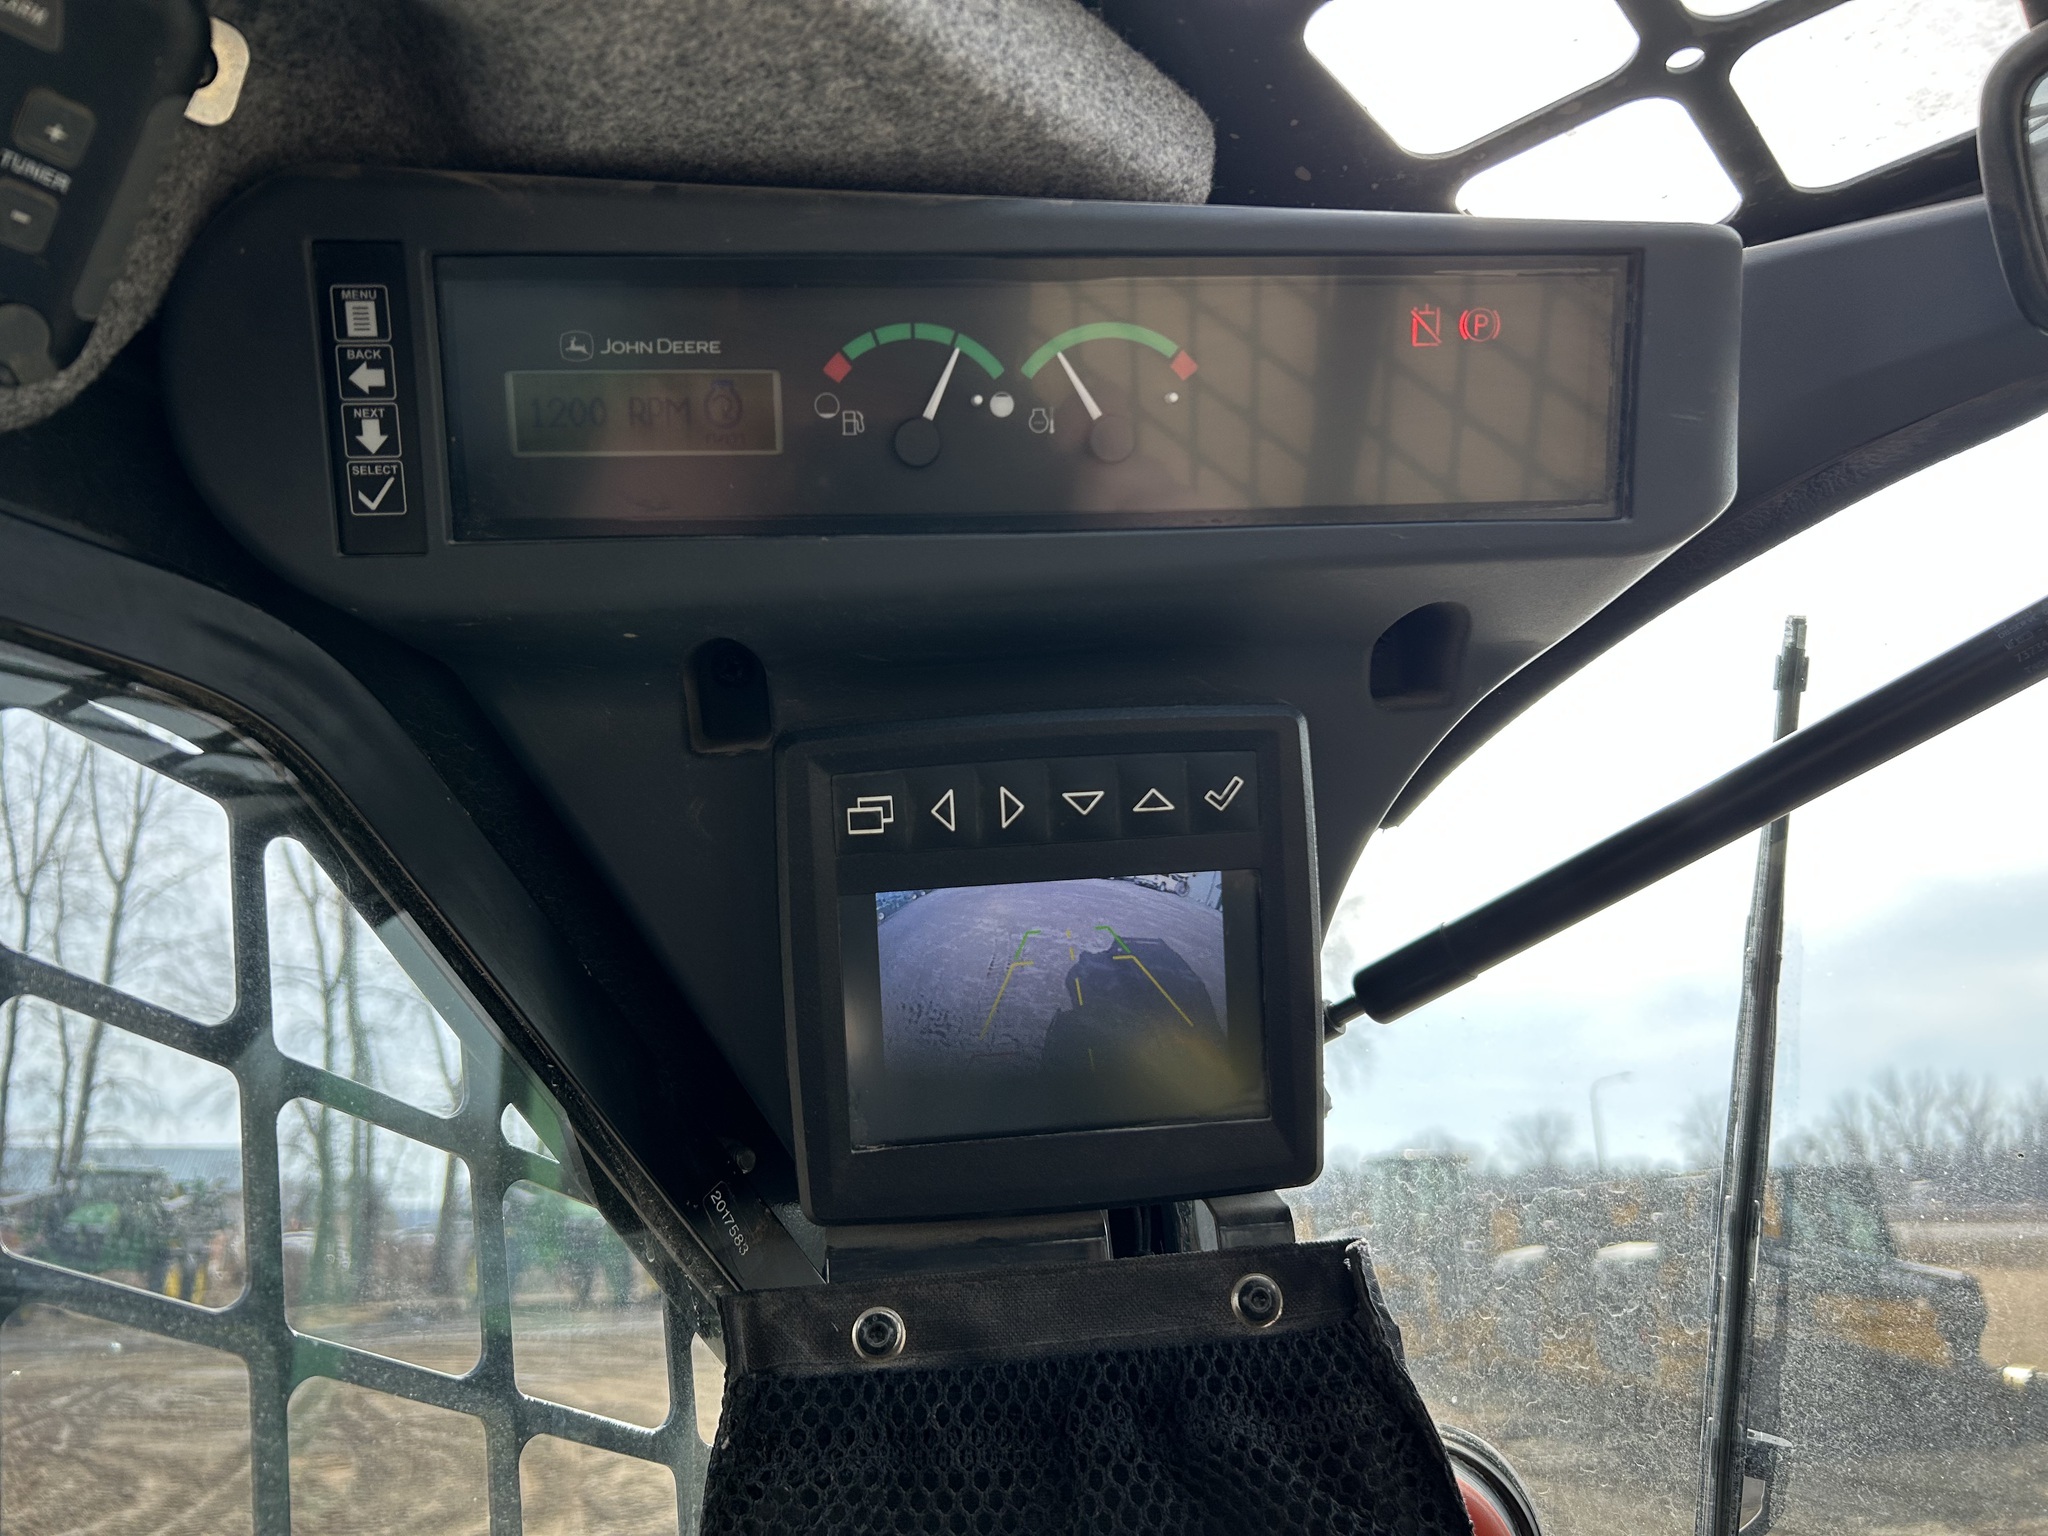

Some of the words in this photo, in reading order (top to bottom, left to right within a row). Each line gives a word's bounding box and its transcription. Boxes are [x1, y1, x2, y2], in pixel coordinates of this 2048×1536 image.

[0, 148, 72, 195] TUNER
[341, 289, 377, 300] MENU
[600, 338, 652, 354] JOHN
[656, 338, 721, 354] DEERE
[346, 349, 382, 360] BACK
[353, 408, 385, 418] NEXT
[530, 396, 608, 429] 1200
[628, 396, 692, 429] RPM
[352, 465, 398, 475] SELECT
[710, 1190, 749, 1256] 2017583
